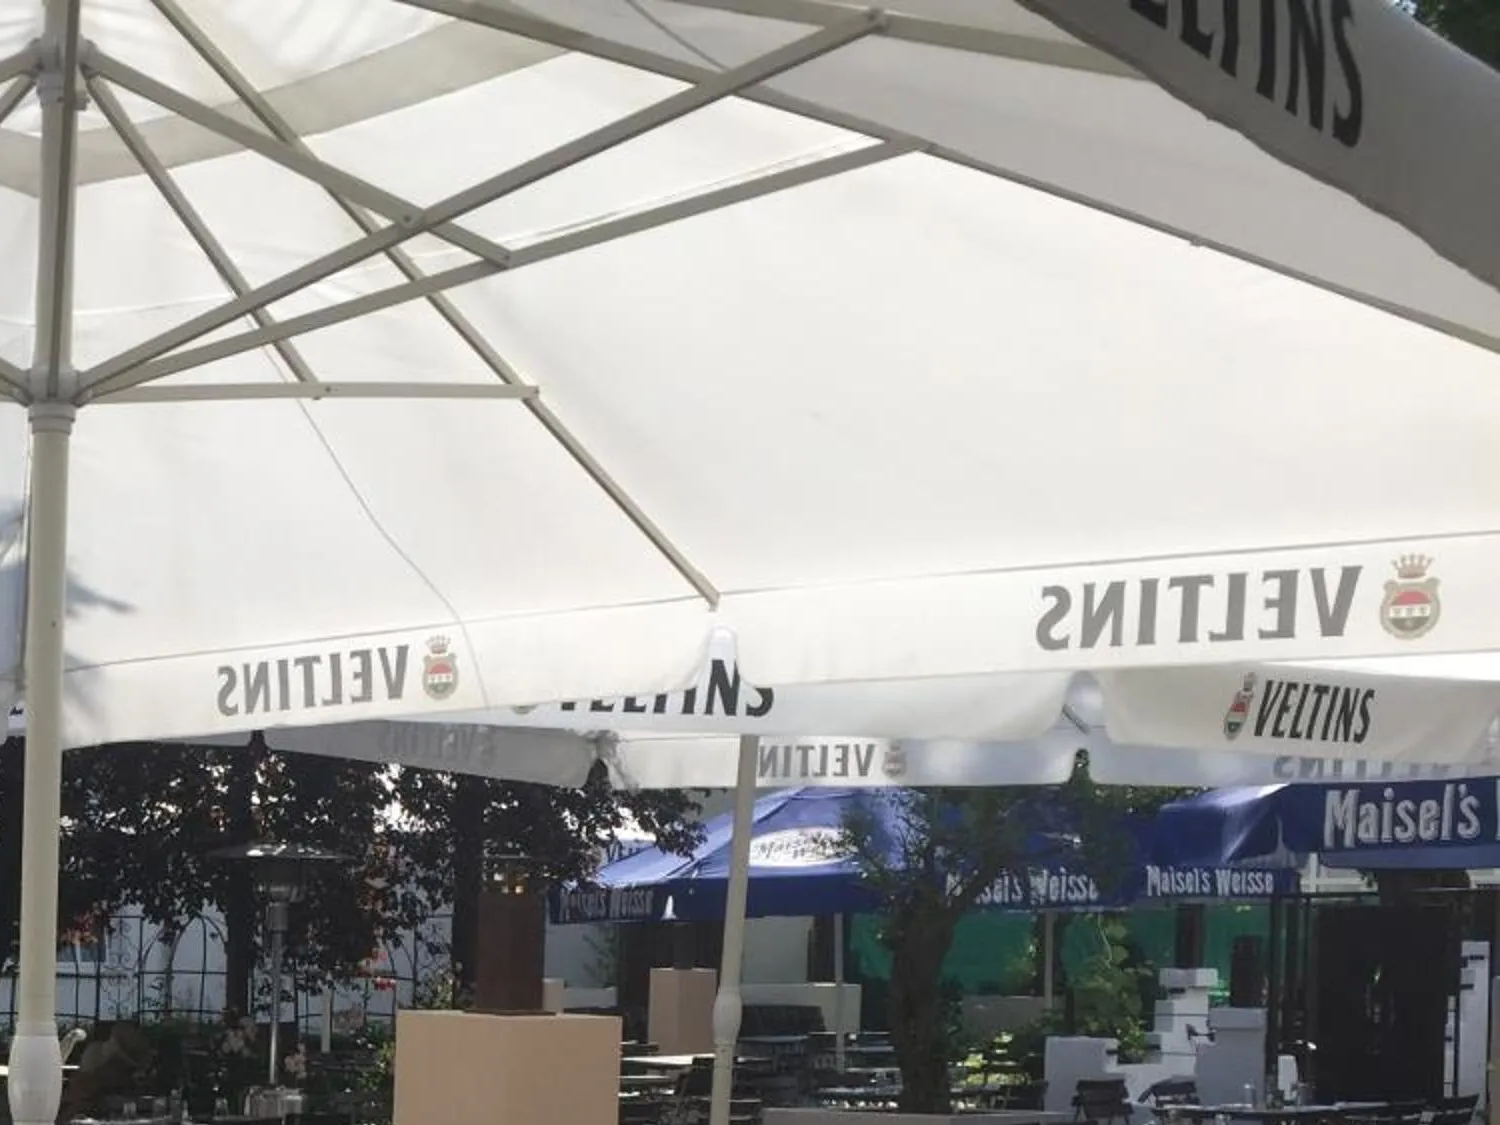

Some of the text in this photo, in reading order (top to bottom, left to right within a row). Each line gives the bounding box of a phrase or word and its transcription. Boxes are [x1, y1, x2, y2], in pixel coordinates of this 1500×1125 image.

[1254, 679, 1376, 744] VELTINS
[1324, 783, 1482, 848] Maisel's
[946, 867, 1024, 907] Msels
[1215, 867, 1275, 897] Weisse
